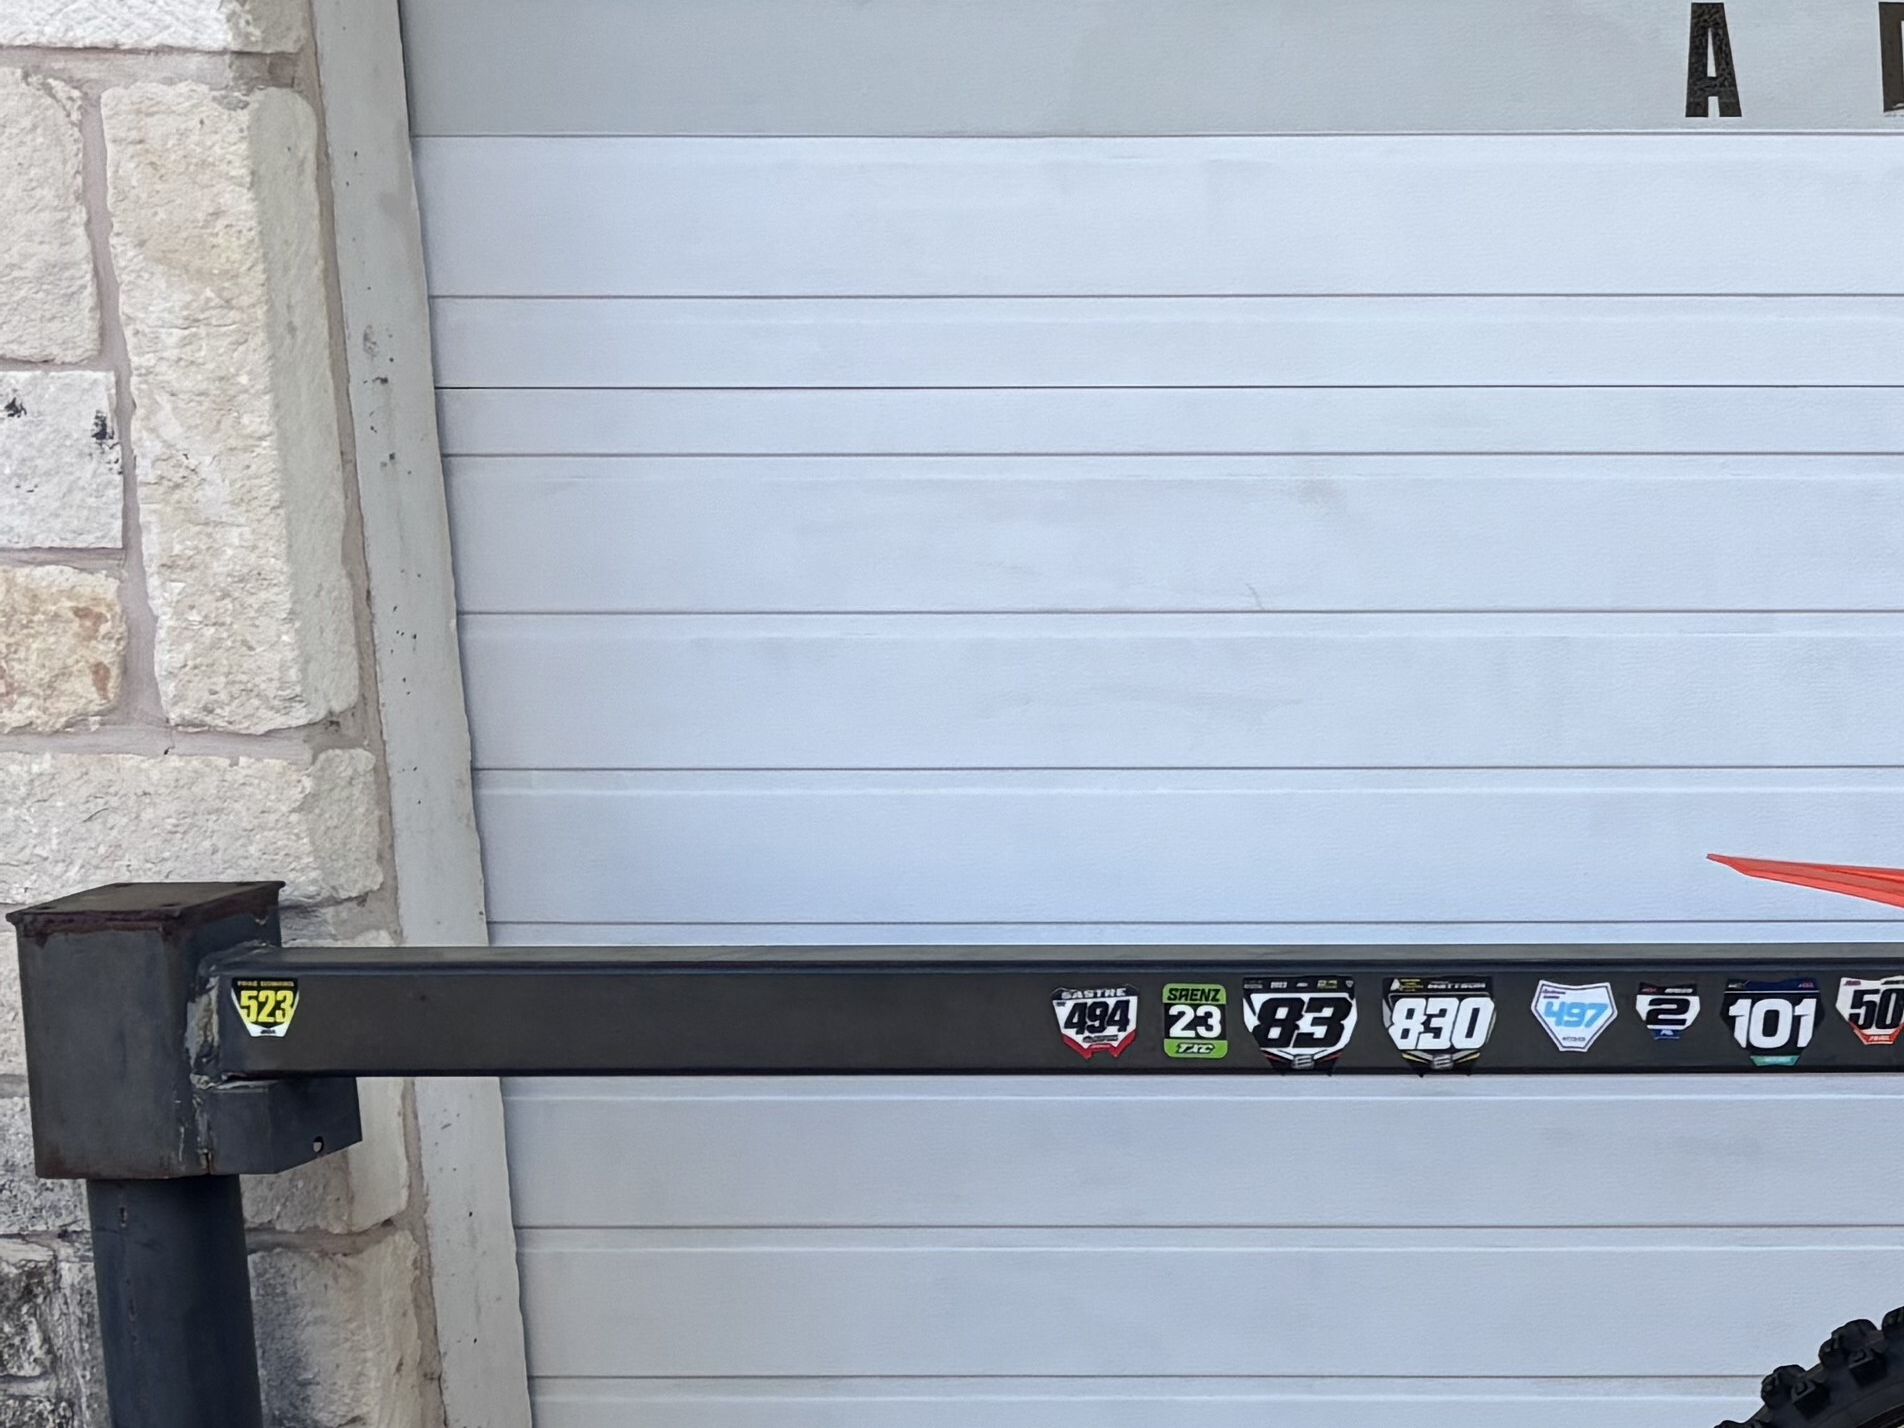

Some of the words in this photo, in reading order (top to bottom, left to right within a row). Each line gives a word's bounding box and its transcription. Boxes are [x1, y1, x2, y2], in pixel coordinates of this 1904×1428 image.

[240, 989, 294, 1023] 523
[1166, 987, 1222, 1003] SAENZ
[1645, 997, 1691, 1026] 2
[1063, 999, 1131, 1036] 494
[1168, 1004, 1222, 1039] 23
[1251, 997, 1353, 1048] 83
[1388, 997, 1495, 1050] 830
[1543, 1001, 1609, 1029] 497
[1728, 998, 1818, 1049] 101
